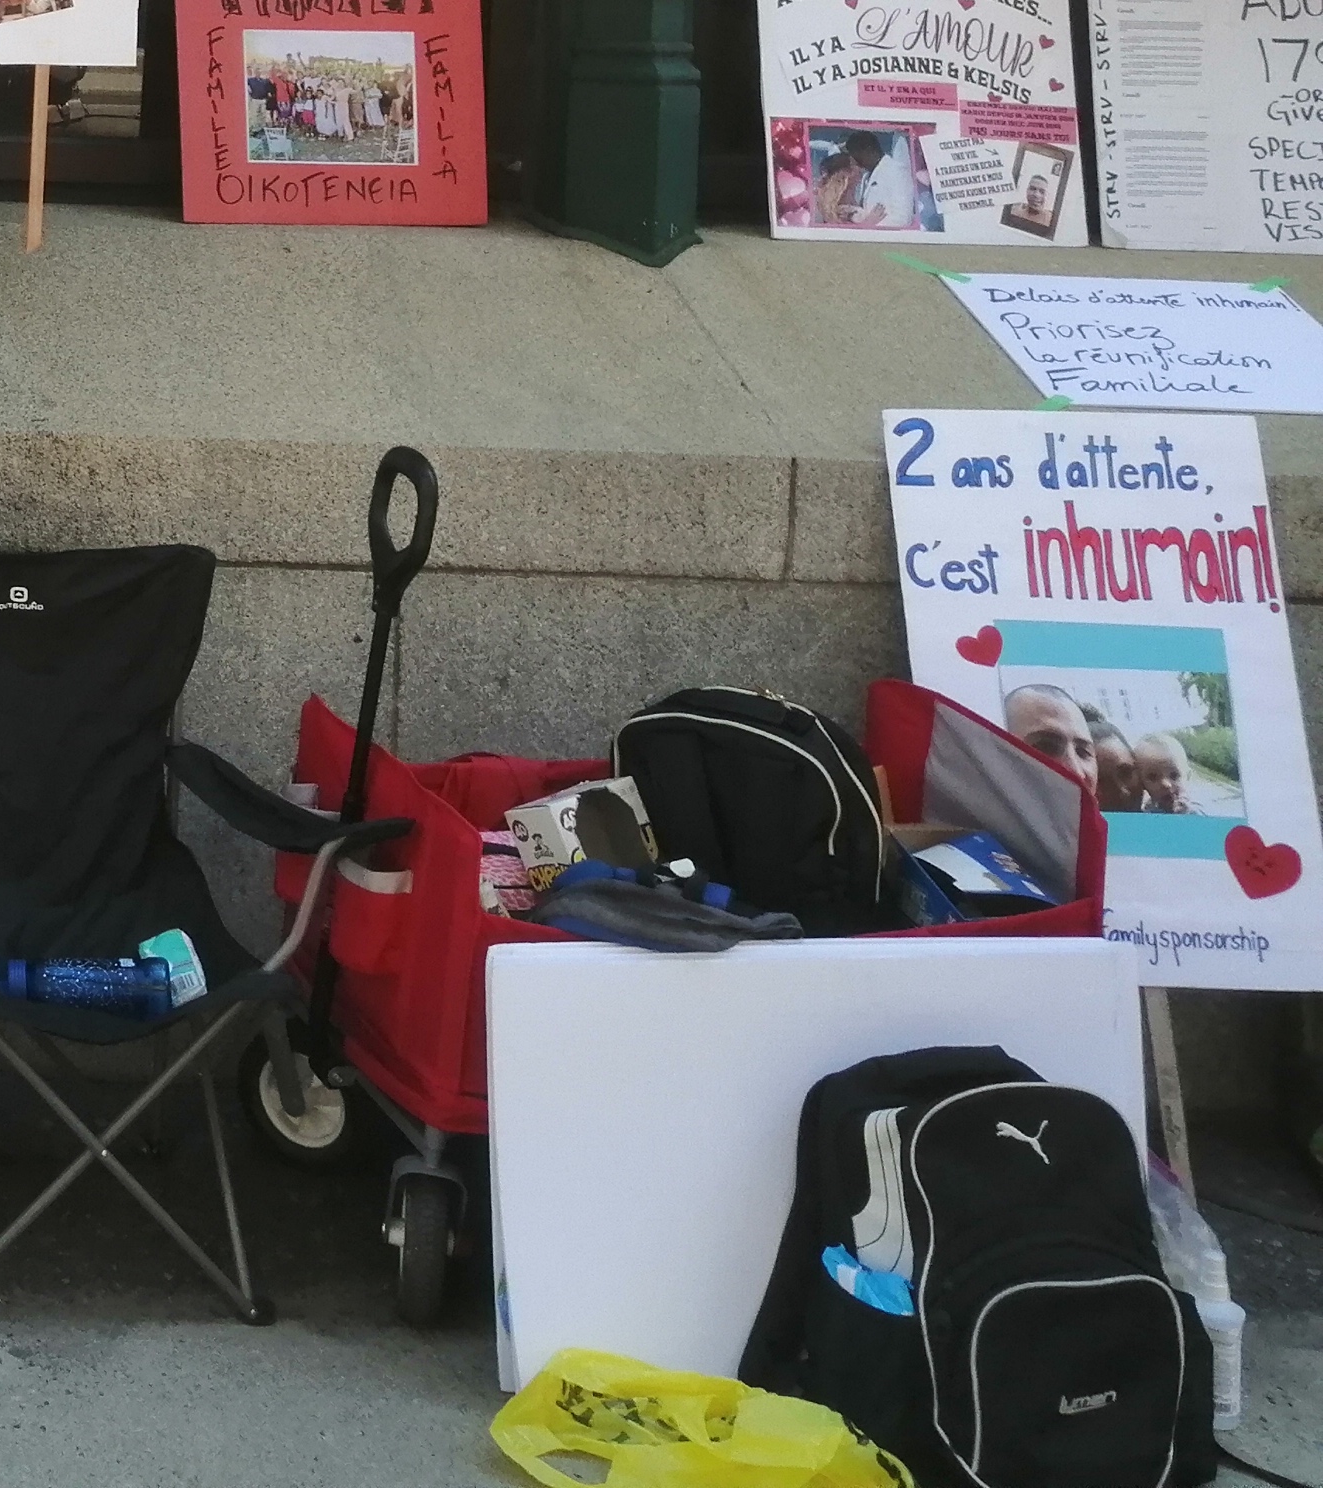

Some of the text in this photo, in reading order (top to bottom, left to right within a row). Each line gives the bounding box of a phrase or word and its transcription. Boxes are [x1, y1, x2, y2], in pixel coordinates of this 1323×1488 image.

[789, 47, 810, 67] IL
[811, 40, 826, 57] Y
[830, 36, 845, 53] A
[793, 56, 1032, 104] IL Y A JOSIANNE & KELSIS
[1023, 346, 1068, 363] la
[892, 417, 1215, 496] 2 ans d'attente,
[1022, 499, 1282, 614] inhumain!
